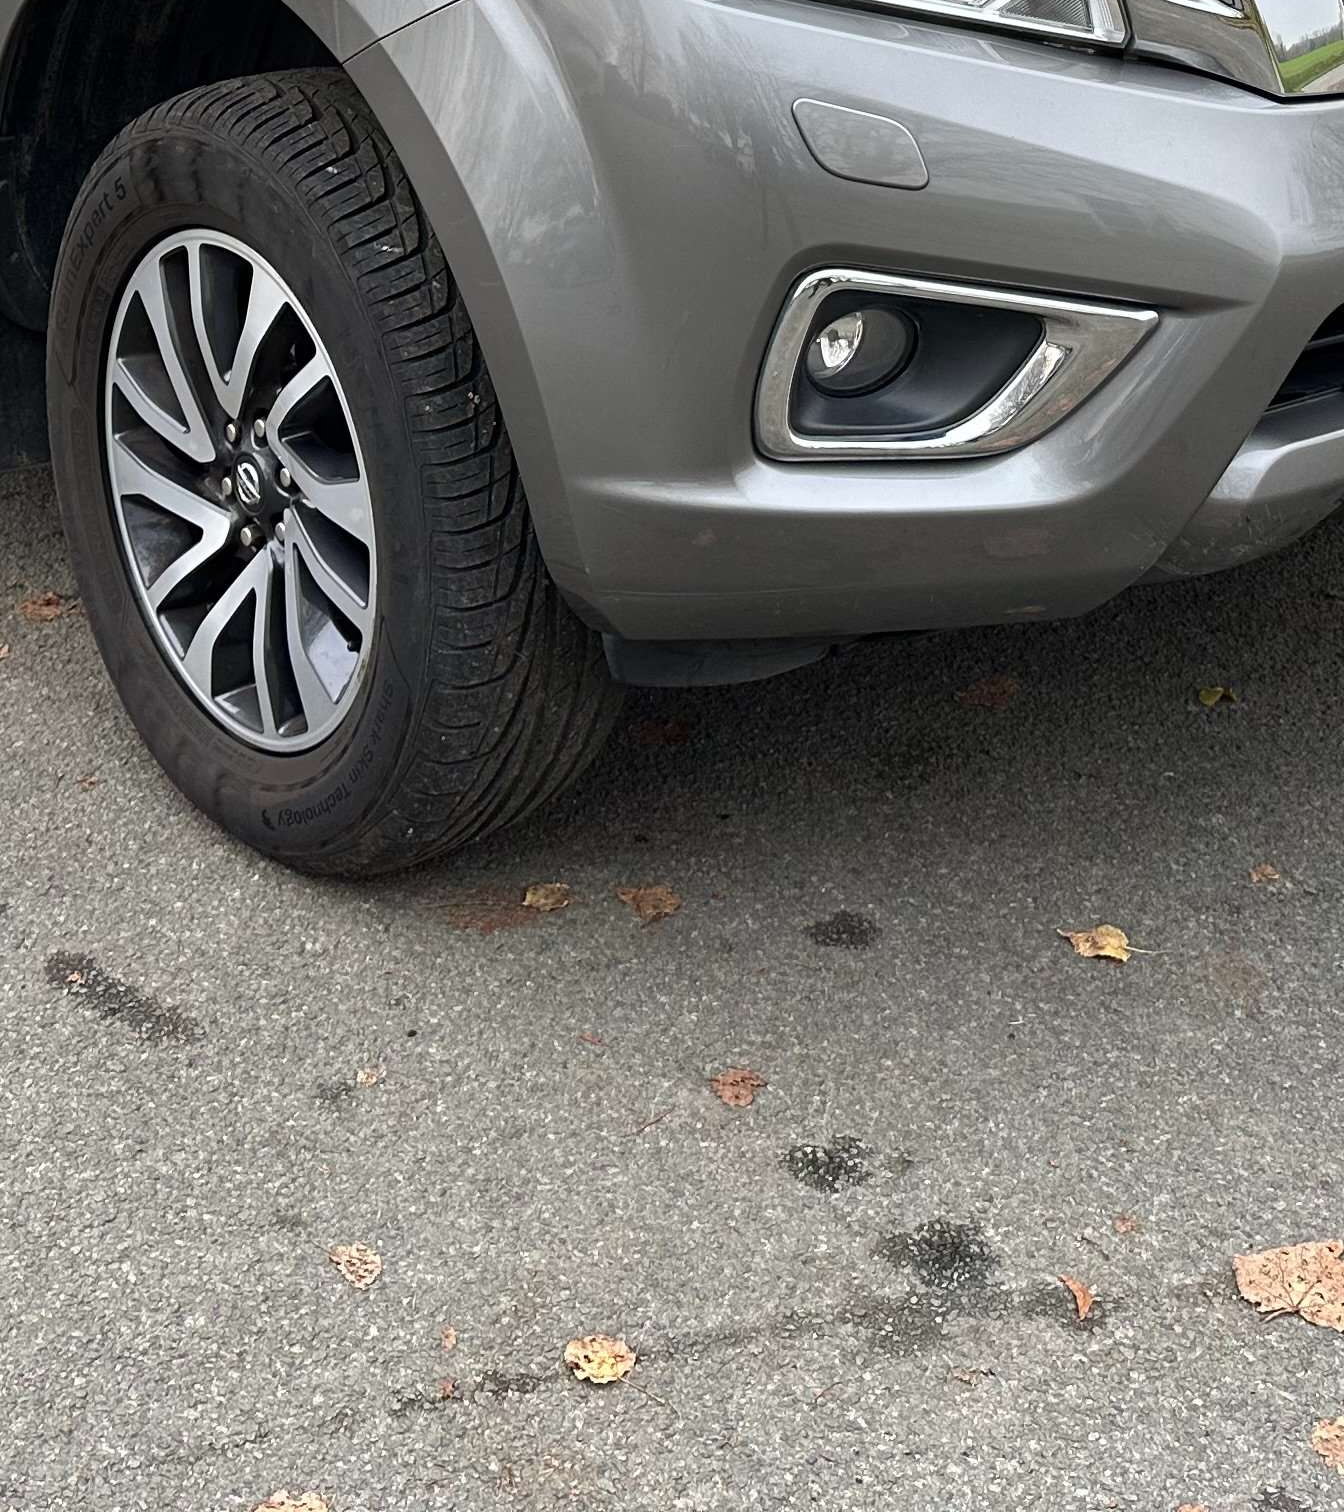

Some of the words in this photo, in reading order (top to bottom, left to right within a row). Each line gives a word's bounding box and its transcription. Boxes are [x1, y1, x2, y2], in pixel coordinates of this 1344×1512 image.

[113, 176, 127, 201] 5
[348, 744, 374, 784] Skin
[277, 782, 353, 826] Technology
